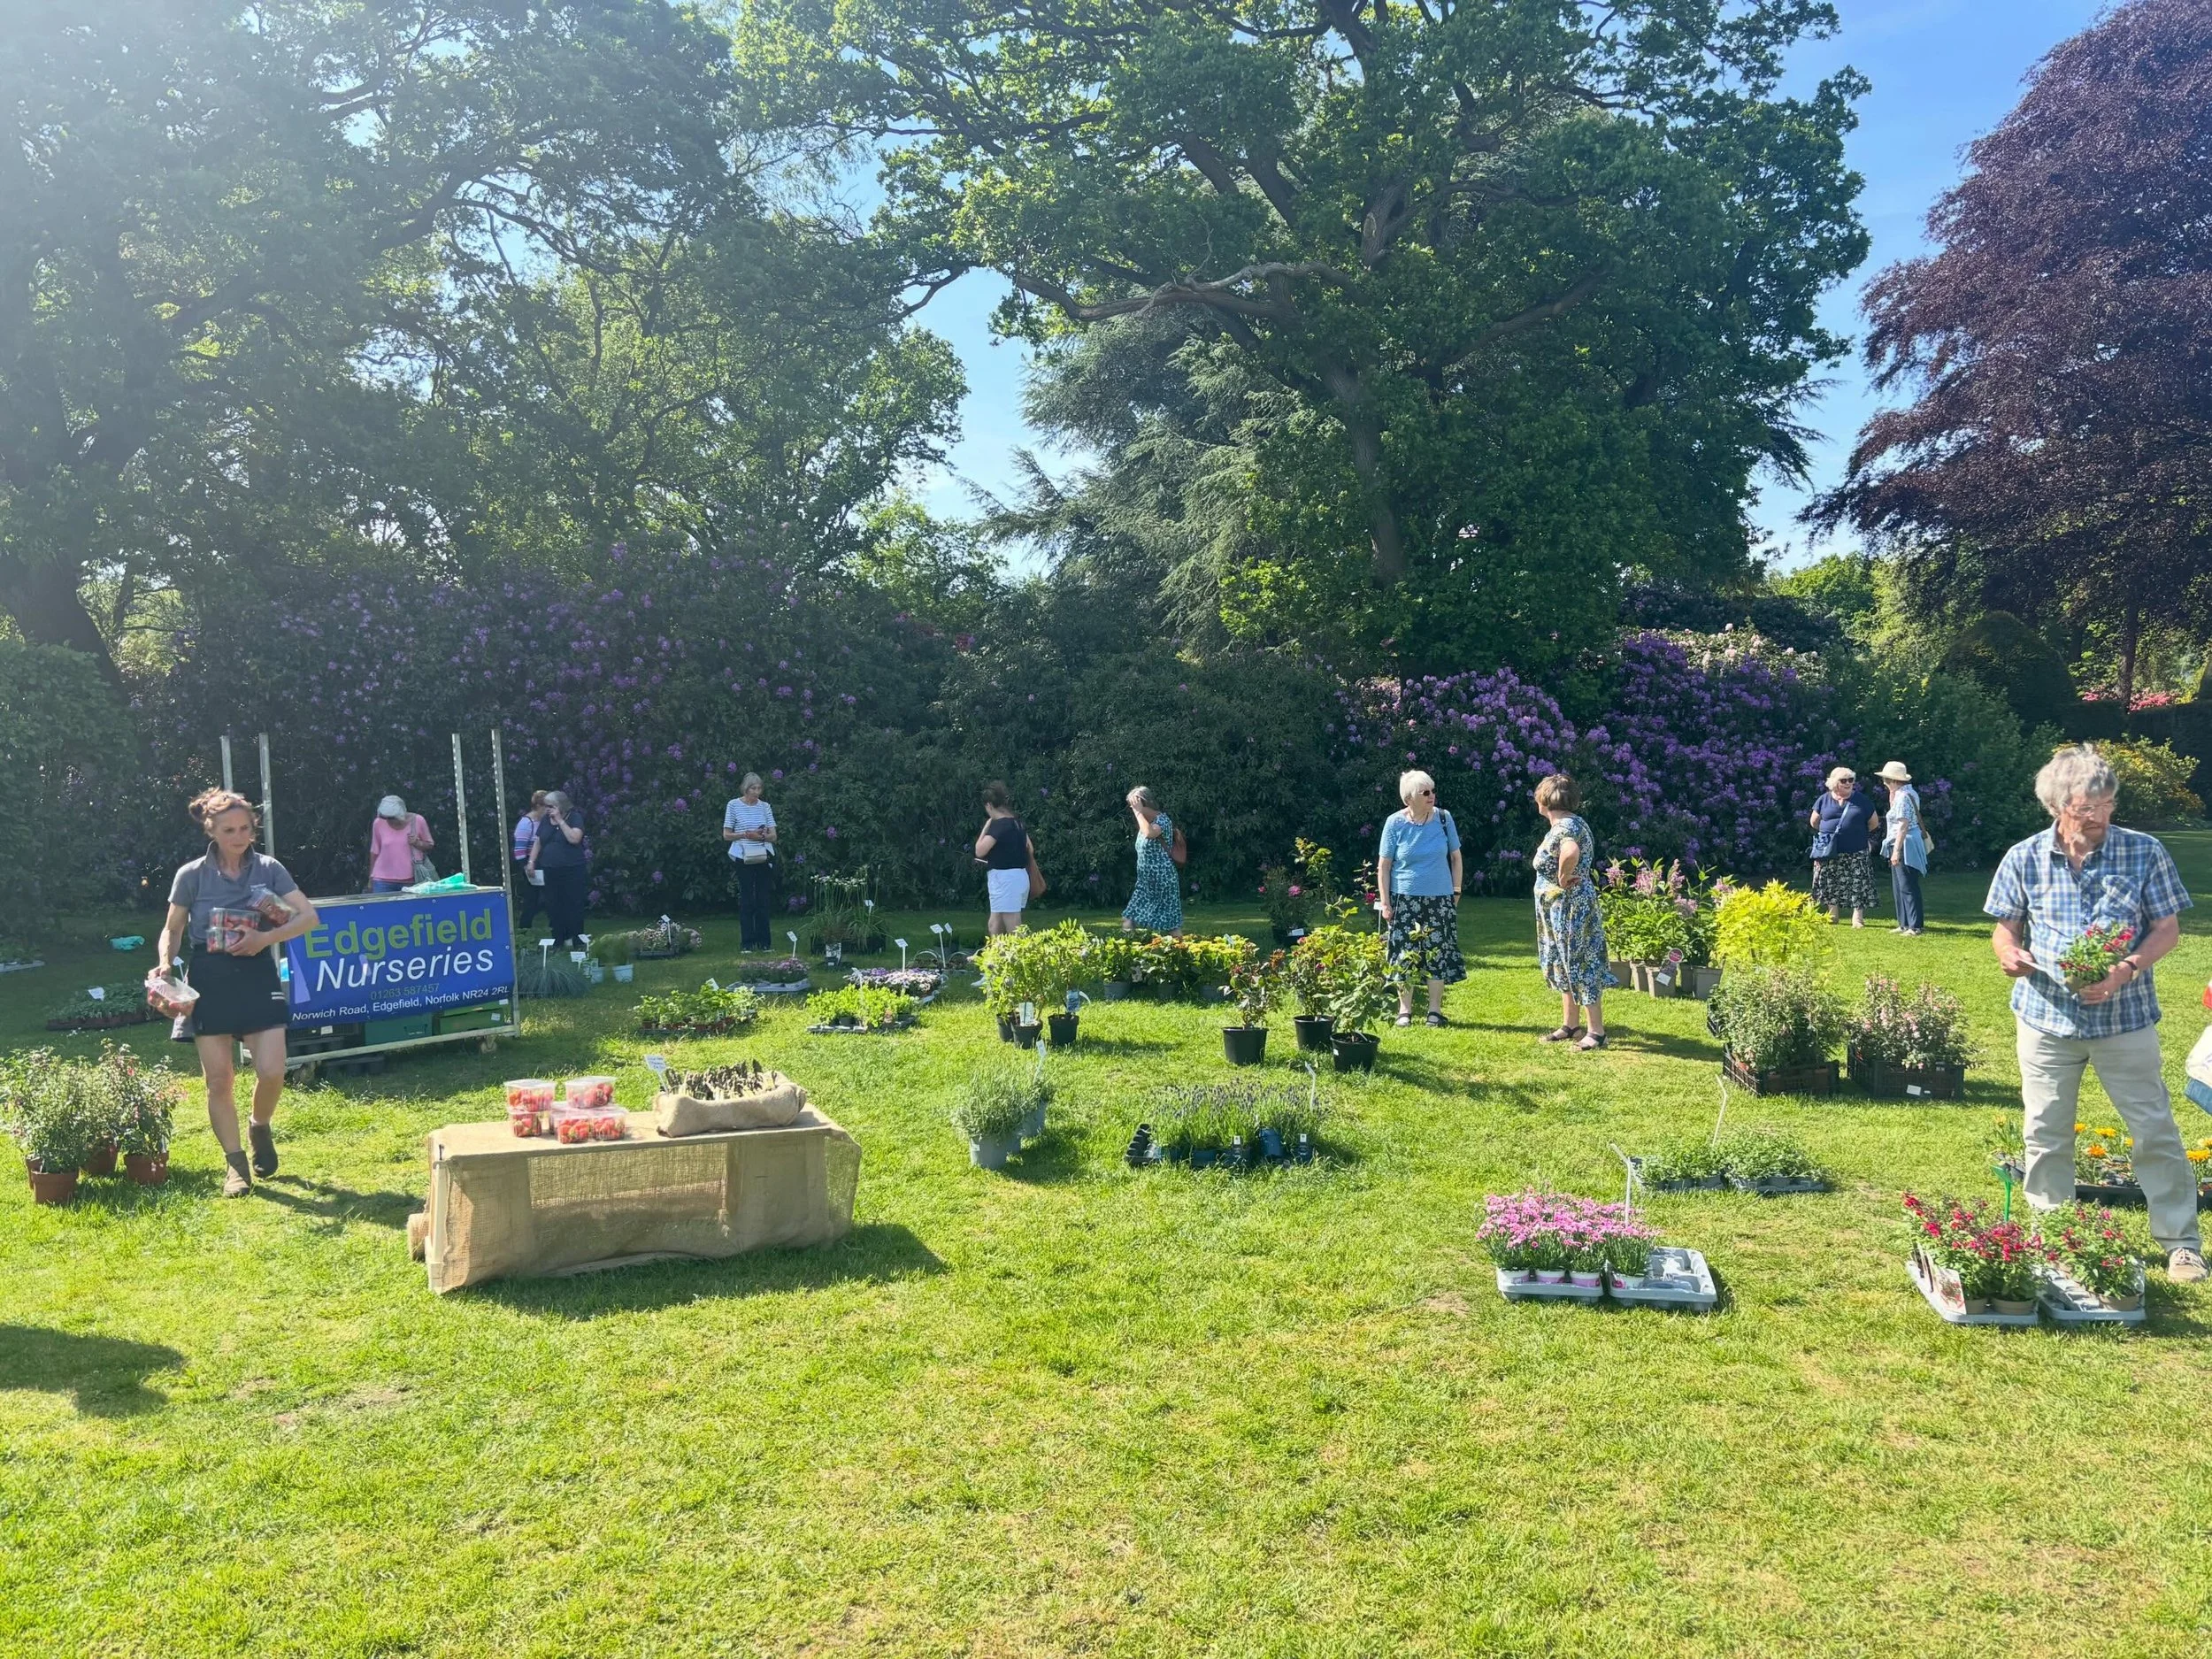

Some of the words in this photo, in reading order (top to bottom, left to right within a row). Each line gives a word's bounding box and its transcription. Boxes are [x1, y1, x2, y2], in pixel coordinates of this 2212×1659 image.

[303, 908, 493, 960] Edgefield
[316, 946, 495, 992] Nurseries
[292, 1010, 336, 1021] Norwich
[339, 1003, 370, 1016] Road,
[373, 997, 422, 1013] Edgefield,
[426, 994, 460, 1005] Norfolk
[463, 988, 488, 1000] NR24
[491, 986, 509, 995] 2RL
[371, 987, 401, 1001] 01263
[403, 983, 440, 996] 587457
